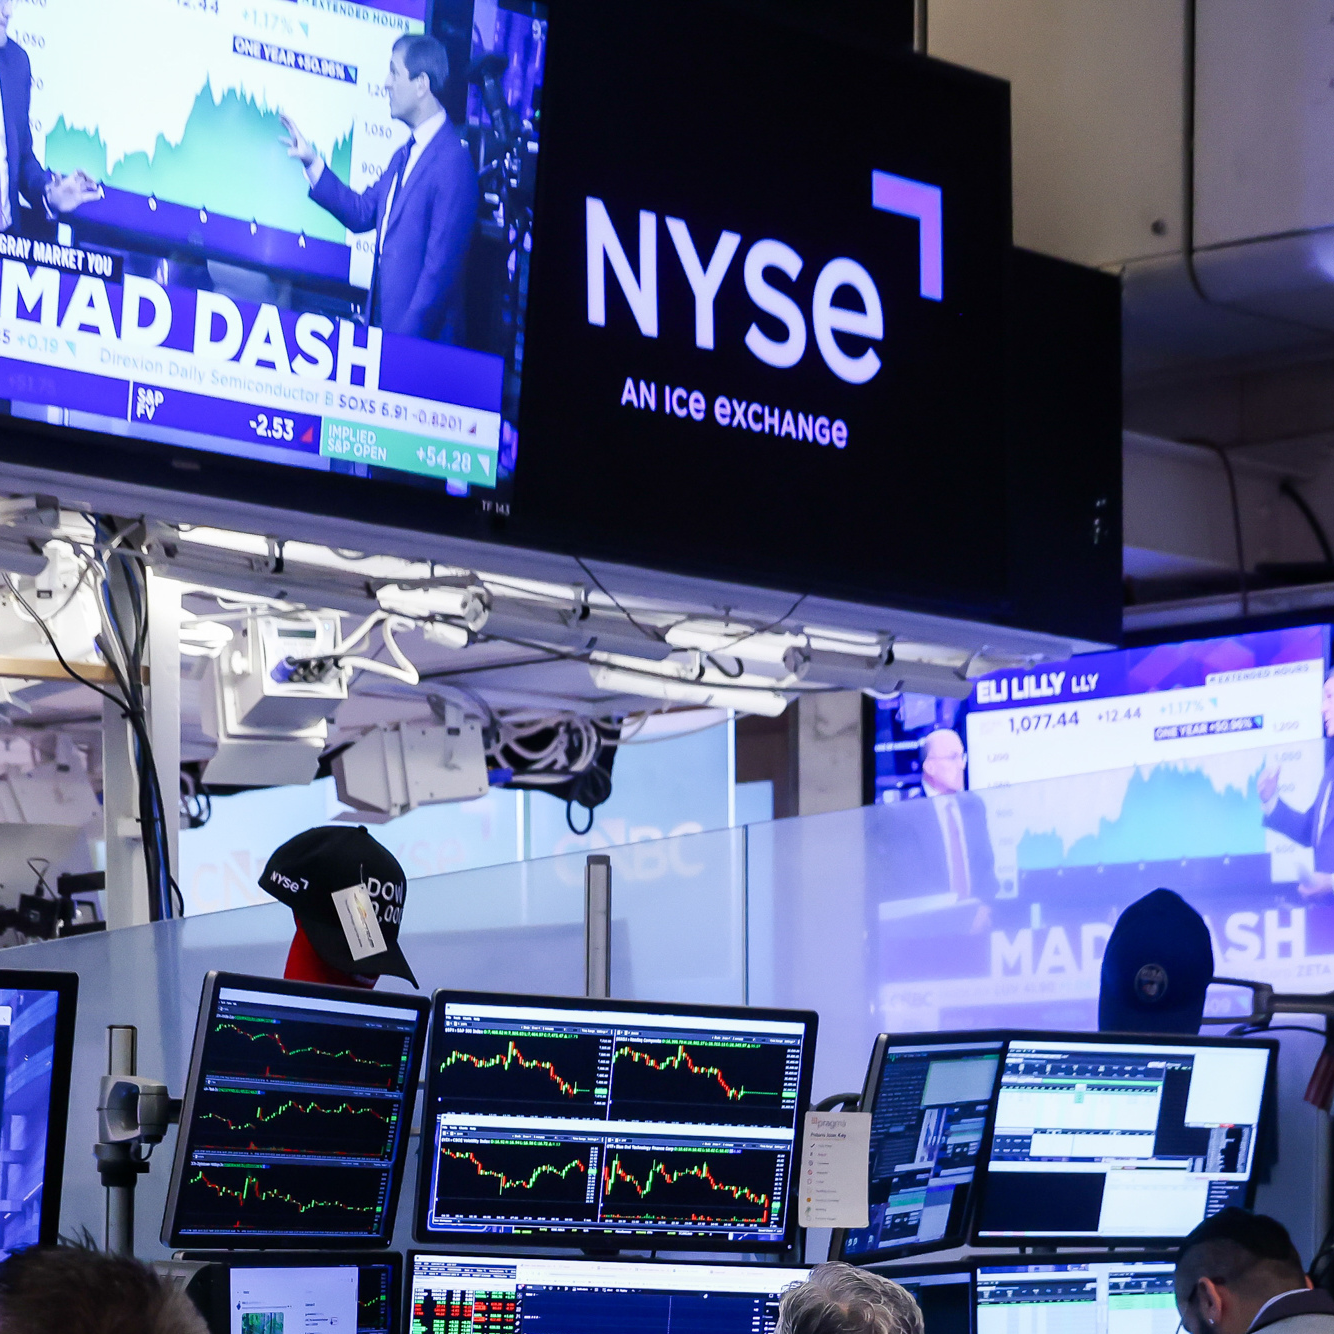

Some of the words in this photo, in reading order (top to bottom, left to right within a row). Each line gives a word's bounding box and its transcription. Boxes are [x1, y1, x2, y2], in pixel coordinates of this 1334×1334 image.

[373, 16, 411, 32] HOURS
[234, 37, 261, 58] ONE
[263, 44, 296, 67] YEAR
[33, 242, 85, 271] MARKET
[86, 252, 114, 277] YOU
[0, 257, 172, 348] MAD
[194, 290, 384, 390] DASH
[99, 346, 164, 376] Direxion
[168, 358, 206, 386] Daily
[210, 368, 321, 406] Semiconductor
[338, 393, 376, 415] SOXS
[381, 403, 409, 420] 6.91
[620, 376, 656, 412] AN
[136, 387, 165, 407] S&P
[135, 403, 156, 421] FV
[248, 415, 295, 440] -2.53
[328, 423, 377, 446] IMPLIED
[327, 437, 351, 455] S&P
[353, 441, 387, 462] OPEN
[415, 446, 472, 473] +54.28
[976, 677, 1008, 704] ELI
[1010, 671, 1066, 701] LILLY
[1070, 672, 1100, 694] LLY
[1008, 710, 1080, 735] 1,077.44
[1097, 706, 1142, 723] +12.44
[367, 877, 404, 904] DOW
